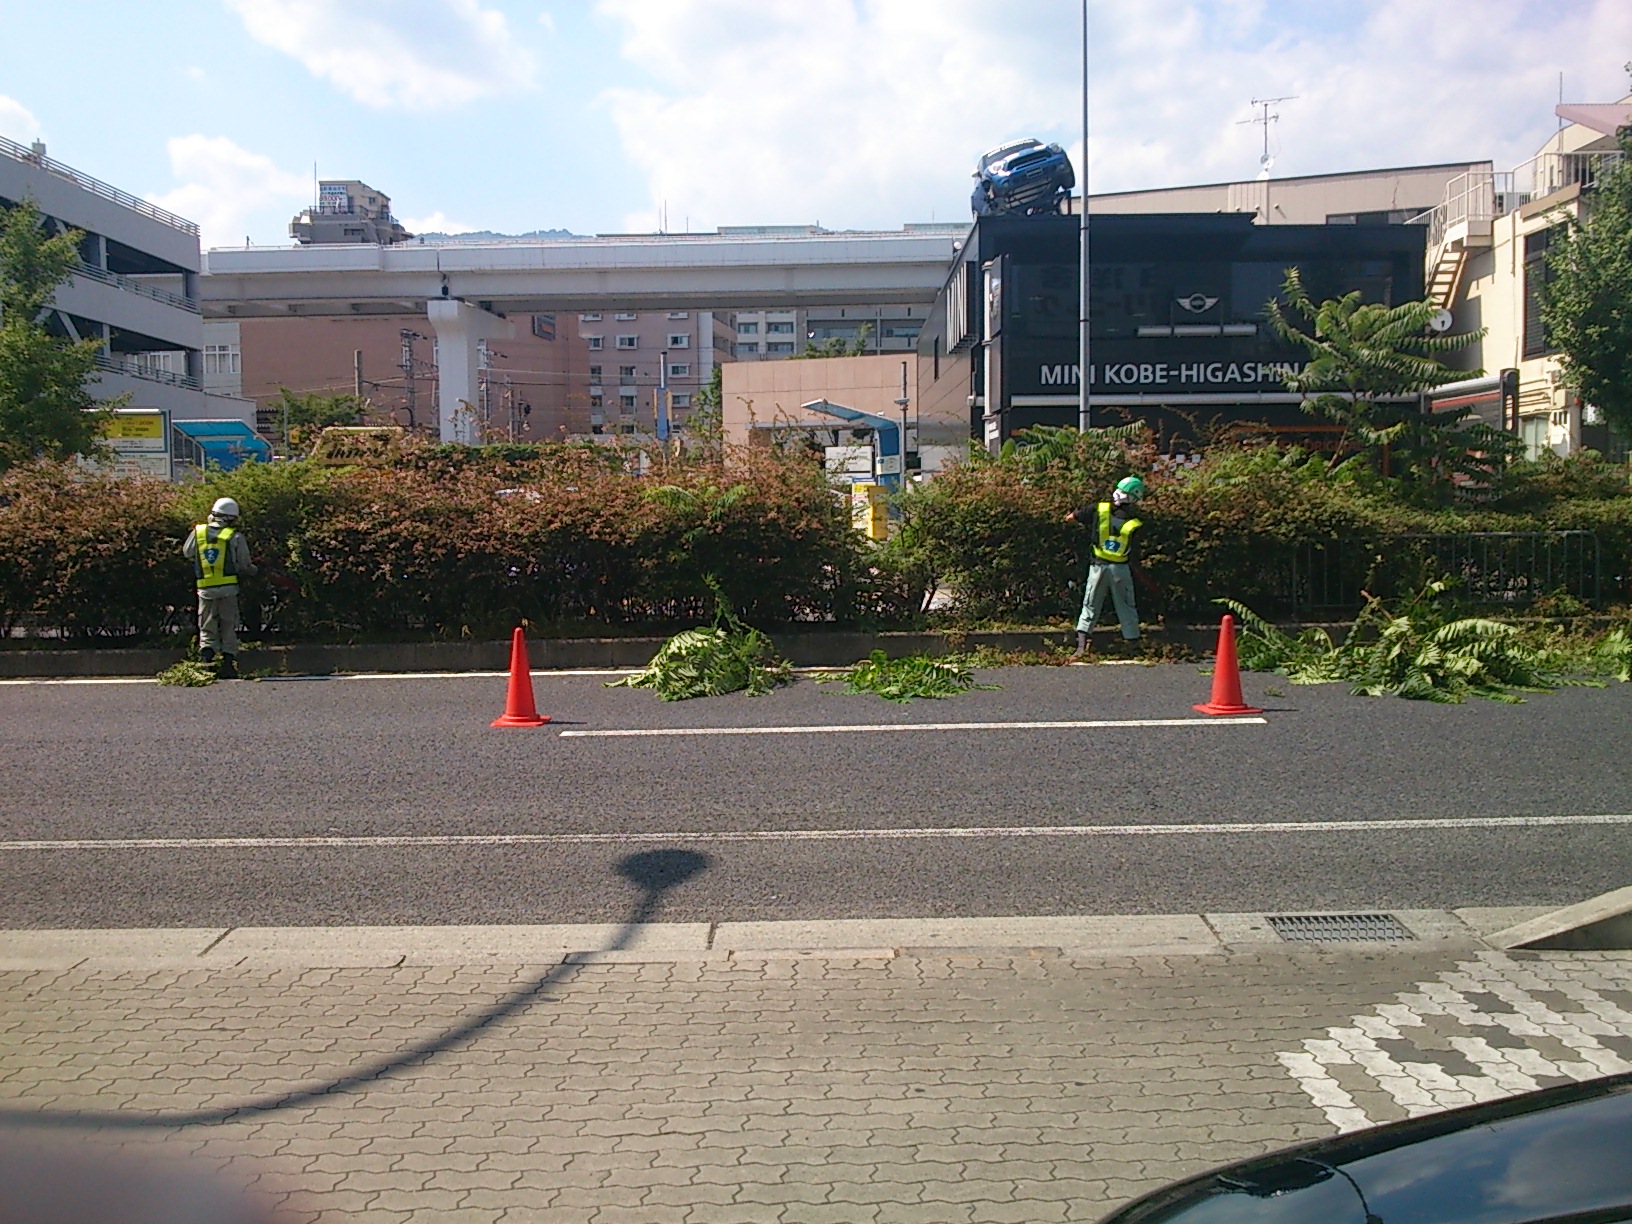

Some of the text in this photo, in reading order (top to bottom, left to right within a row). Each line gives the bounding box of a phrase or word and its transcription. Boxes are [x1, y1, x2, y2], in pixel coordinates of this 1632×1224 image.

[1040, 362, 1326, 385] MINI KOBE-HIGASHIN
[1108, 541, 1115, 550] 2
[208, 549, 215, 558] 2
